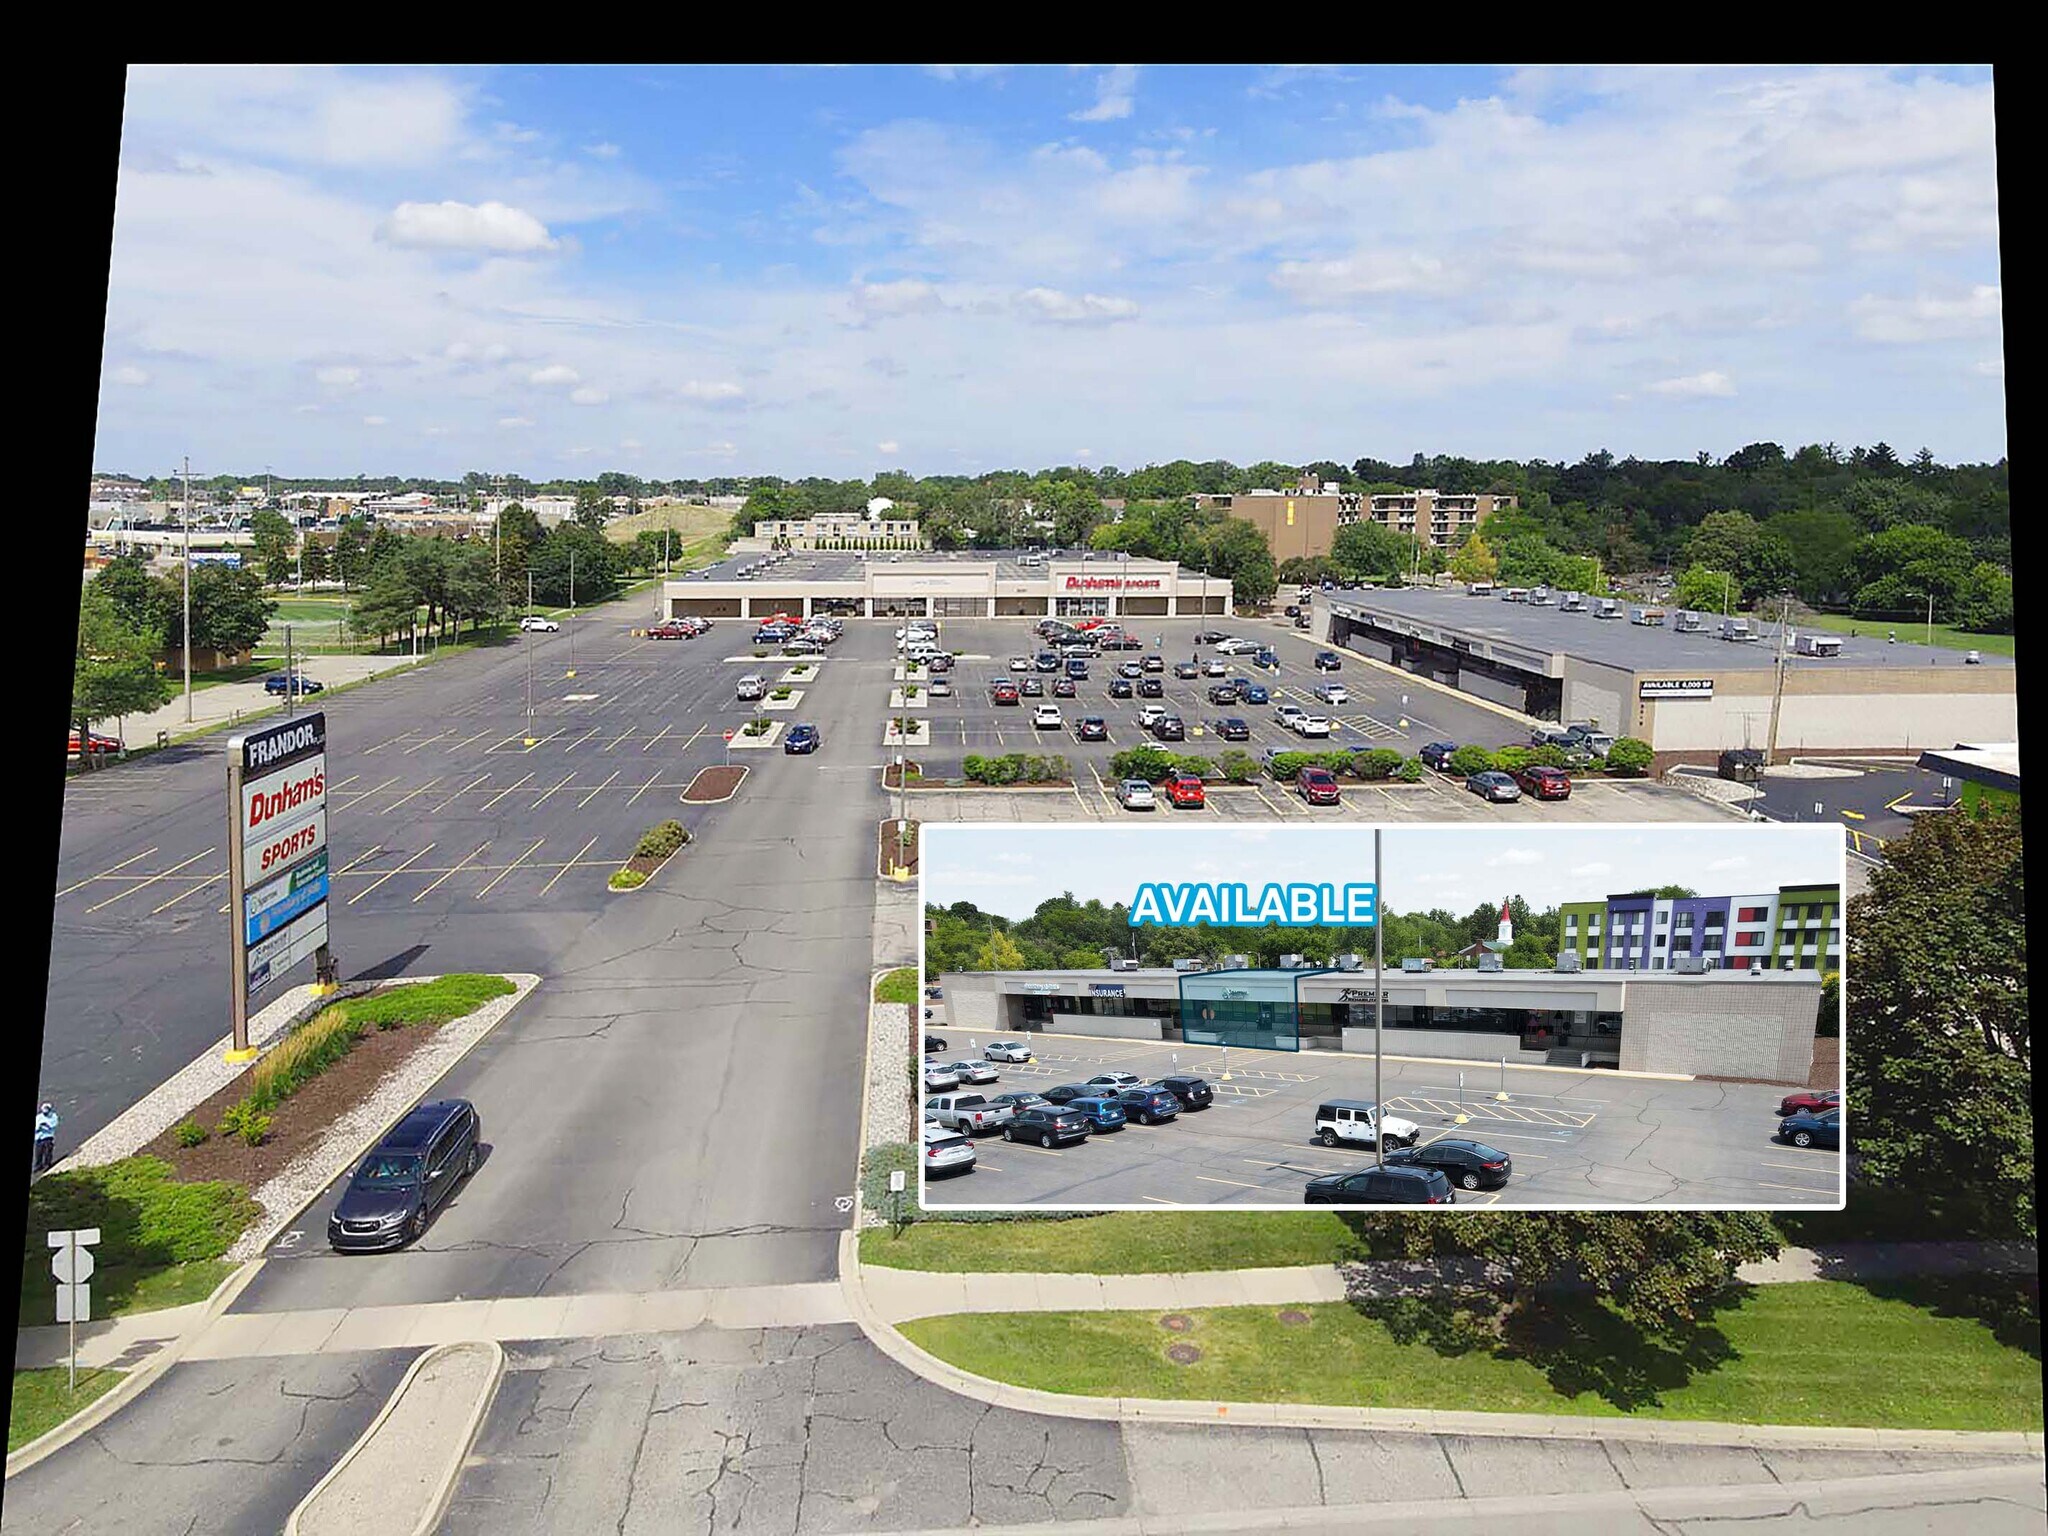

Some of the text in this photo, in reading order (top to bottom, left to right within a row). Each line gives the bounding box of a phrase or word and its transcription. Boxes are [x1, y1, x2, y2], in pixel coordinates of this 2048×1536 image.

[1643, 681, 1680, 689] AVAILABLE
[249, 724, 314, 767] FRANDOR
[250, 767, 324, 827] Dunham's
[261, 824, 315, 870] SPORTS
[1351, 989, 1389, 997] PREMR
